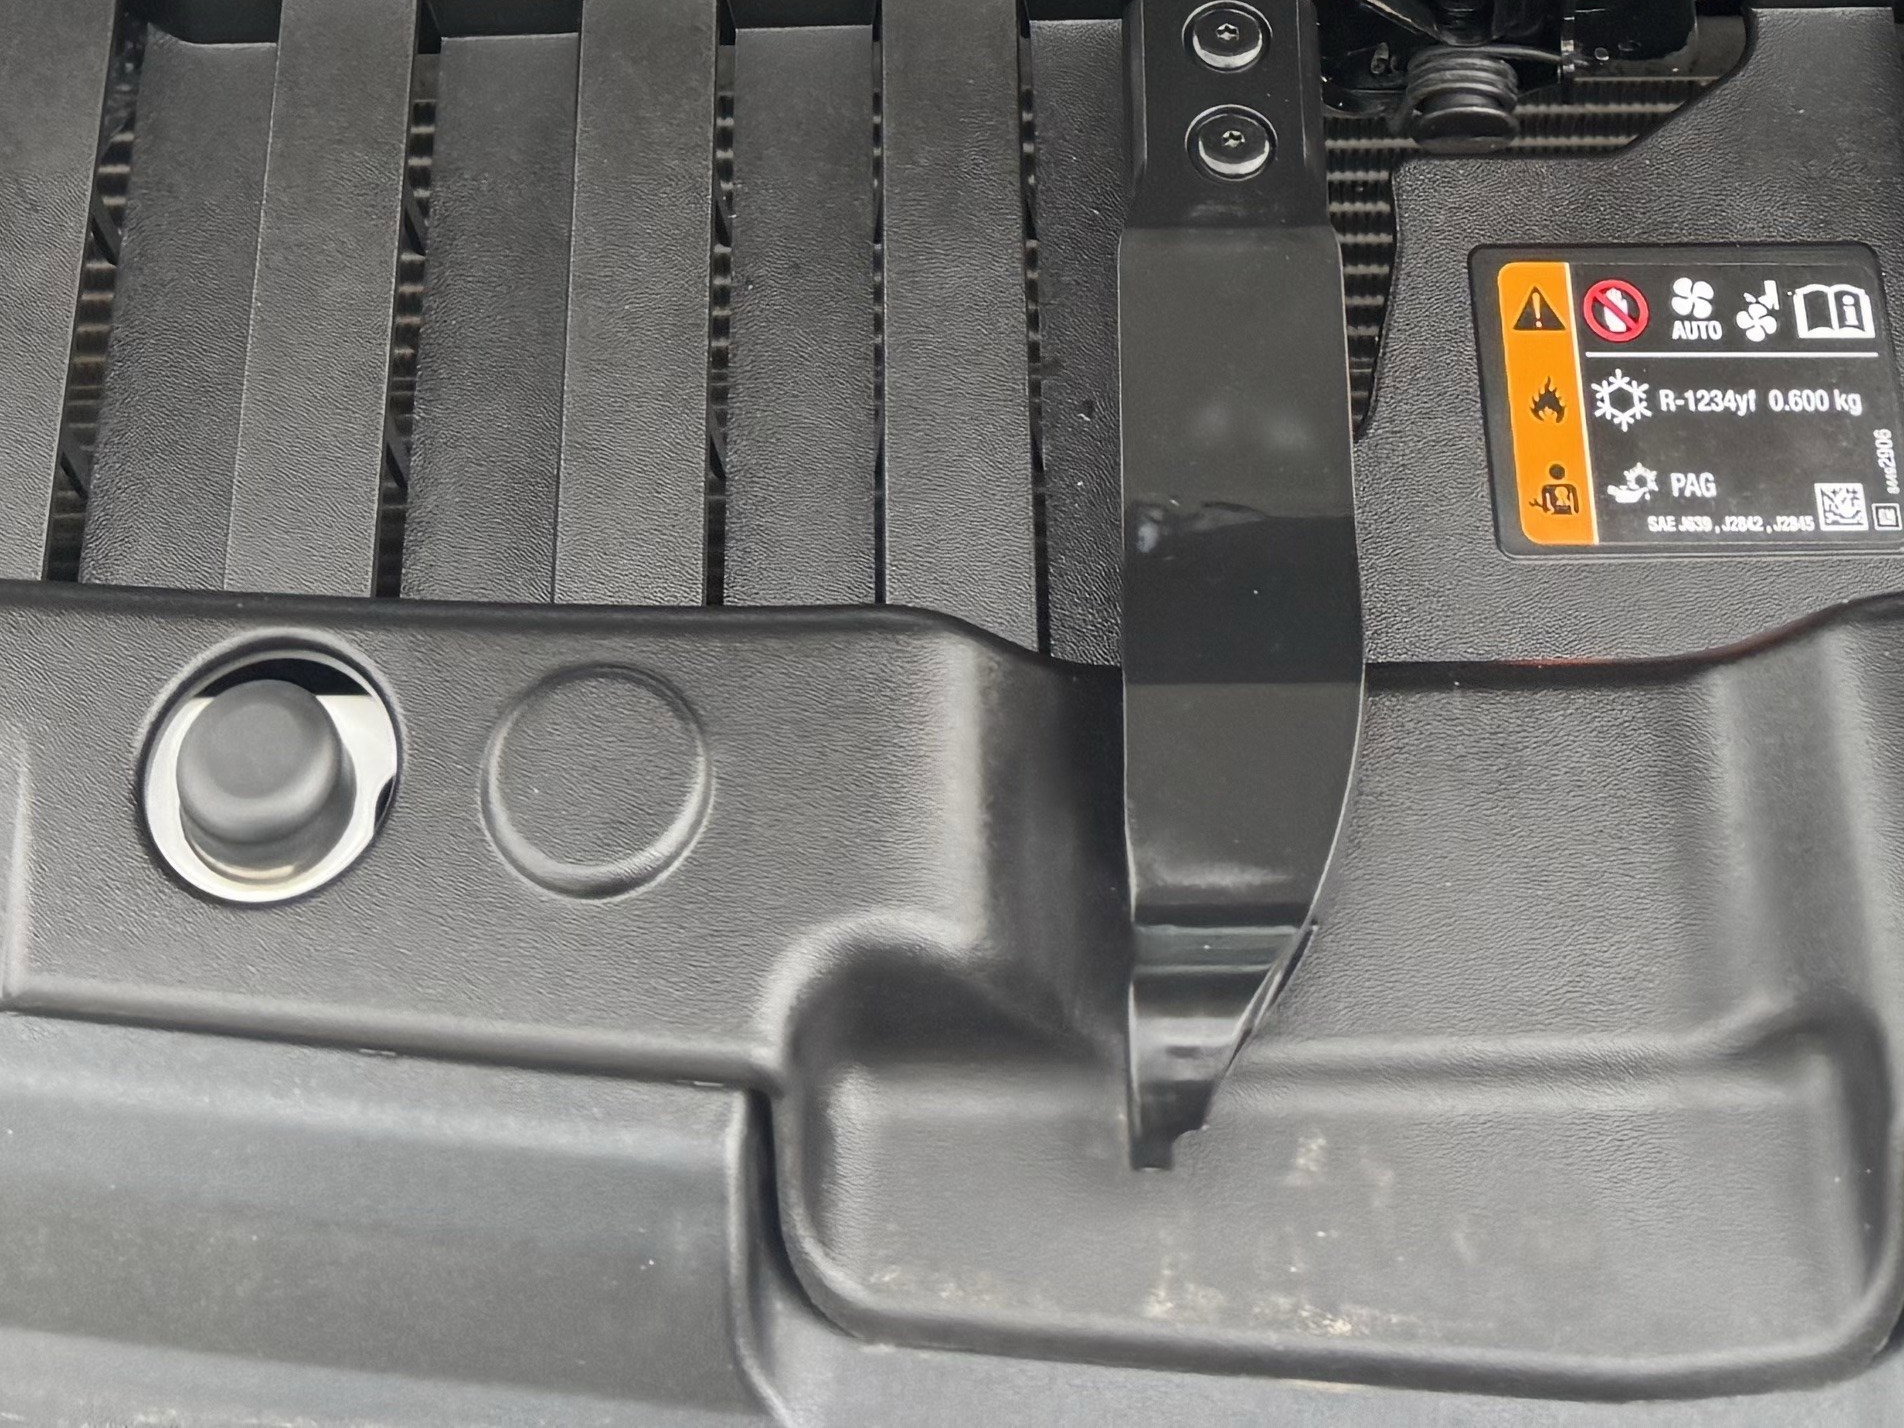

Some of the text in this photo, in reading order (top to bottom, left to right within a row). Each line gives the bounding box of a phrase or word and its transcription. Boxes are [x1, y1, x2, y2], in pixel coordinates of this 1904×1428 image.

[1671, 320, 1723, 341] AUTO
[1658, 388, 1864, 417] R-1234yf 0.600 kg
[1669, 472, 1718, 498] PAG
[1647, 515, 1676, 533] SAE
